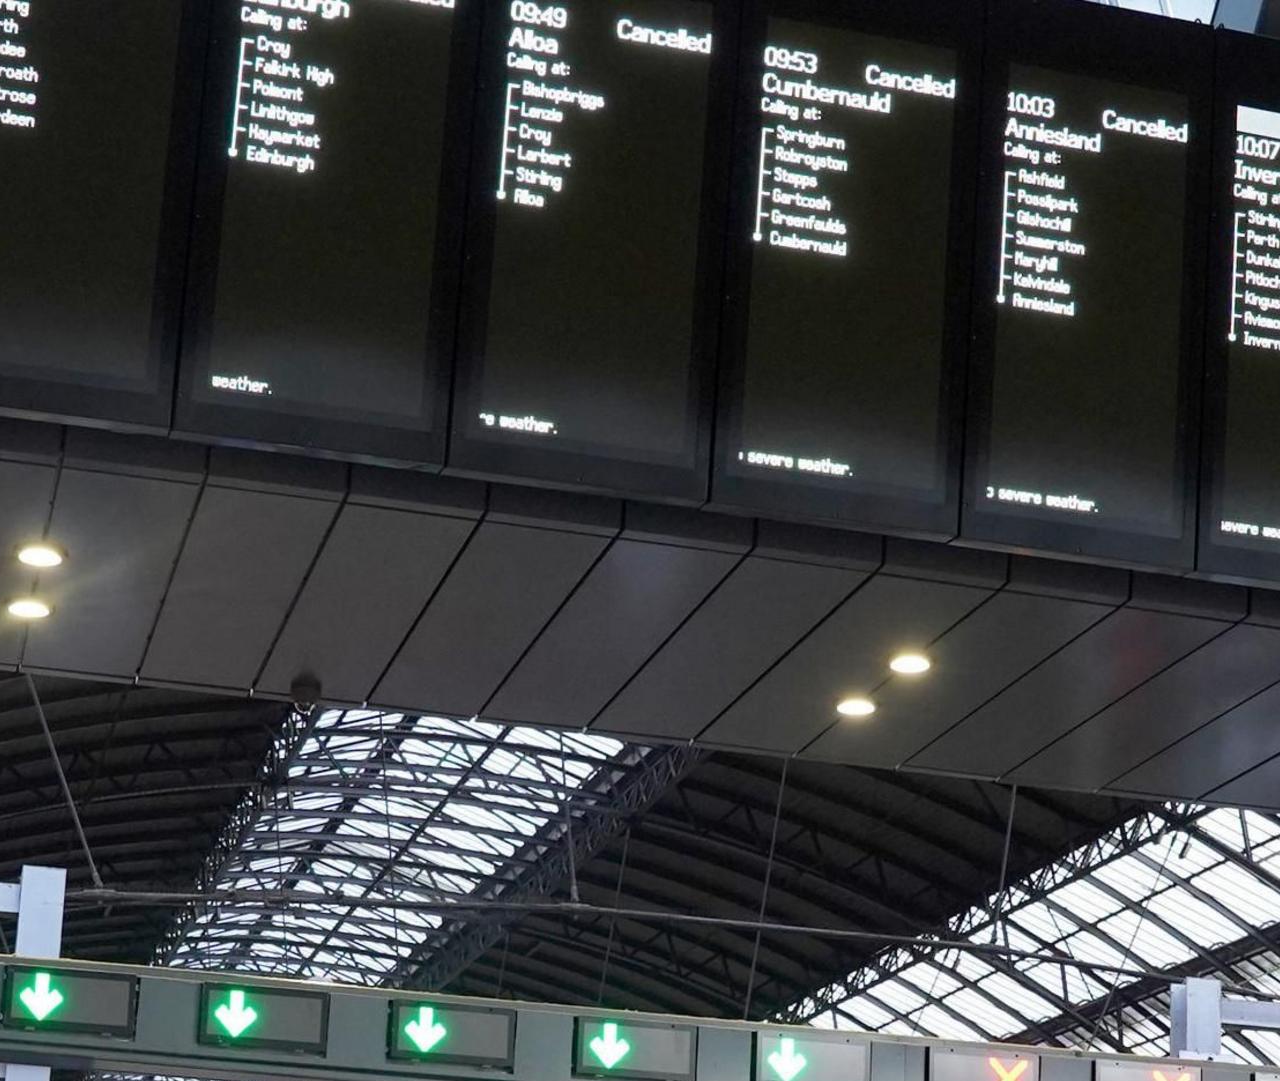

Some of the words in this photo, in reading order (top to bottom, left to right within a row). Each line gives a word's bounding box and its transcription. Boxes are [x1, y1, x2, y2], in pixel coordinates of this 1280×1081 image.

[241, 6, 283, 31] Calling
[287, 18, 307, 31] at:
[510, 0, 568, 28] 09:49
[257, 35, 291, 60] Croy
[508, 27, 559, 54] Alloa
[617, 19, 712, 54] Cancelled
[255, 57, 301, 79] Falkirk
[306, 64, 334, 87] High
[507, 52, 547, 76] Calling
[551, 61, 570, 76] at:
[764, 46, 818, 74] 09:53
[253, 79, 304, 101] Polmont
[762, 72, 891, 114] Cumbernauld
[865, 64, 956, 99] Cancelled
[522, 80, 605, 110] Bishopbriggs
[1007, 91, 1055, 119] 10:03
[251, 101, 315, 127] Linlithgow
[521, 101, 563, 123] Lenzie
[761, 97, 799, 120] Calling
[248, 123, 320, 149] Haymarket
[519, 124, 552, 146] Croy
[776, 124, 845, 150] Springburn
[1005, 117, 1101, 153] Anniesland
[1102, 109, 1188, 143] Cancelled
[246, 146, 315, 173] Edinburgh
[517, 145, 571, 168] Larbert
[775, 146, 848, 172] Robroyston
[1004, 141, 1039, 164] Calling
[1236, 134, 1280, 160] 10:07
[516, 167, 563, 193] Stirling
[774, 167, 817, 189] Stepps
[1018, 169, 1065, 190] Ashfield
[514, 189, 544, 208] Alloa
[772, 188, 831, 211] Gartcosh
[1018, 189, 1078, 213] Possilpark
[1233, 183, 1267, 206] Calling
[771, 209, 847, 234] Greenfaulds
[770, 230, 847, 257] Cumbernauld
[1016, 231, 1085, 255] Summerston
[1246, 230, 1280, 249] Perth
[1015, 251, 1058, 273] Maryhill
[1013, 273, 1071, 294] Kelvindale
[1012, 293, 1074, 316] Anniesland
[212, 373, 272, 395] weather.
[500, 416, 558, 435] weather.
[747, 452, 793, 470] severe
[798, 458, 853, 477] weather.
[999, 487, 1041, 506] severe
[1046, 494, 1099, 513] weather.
